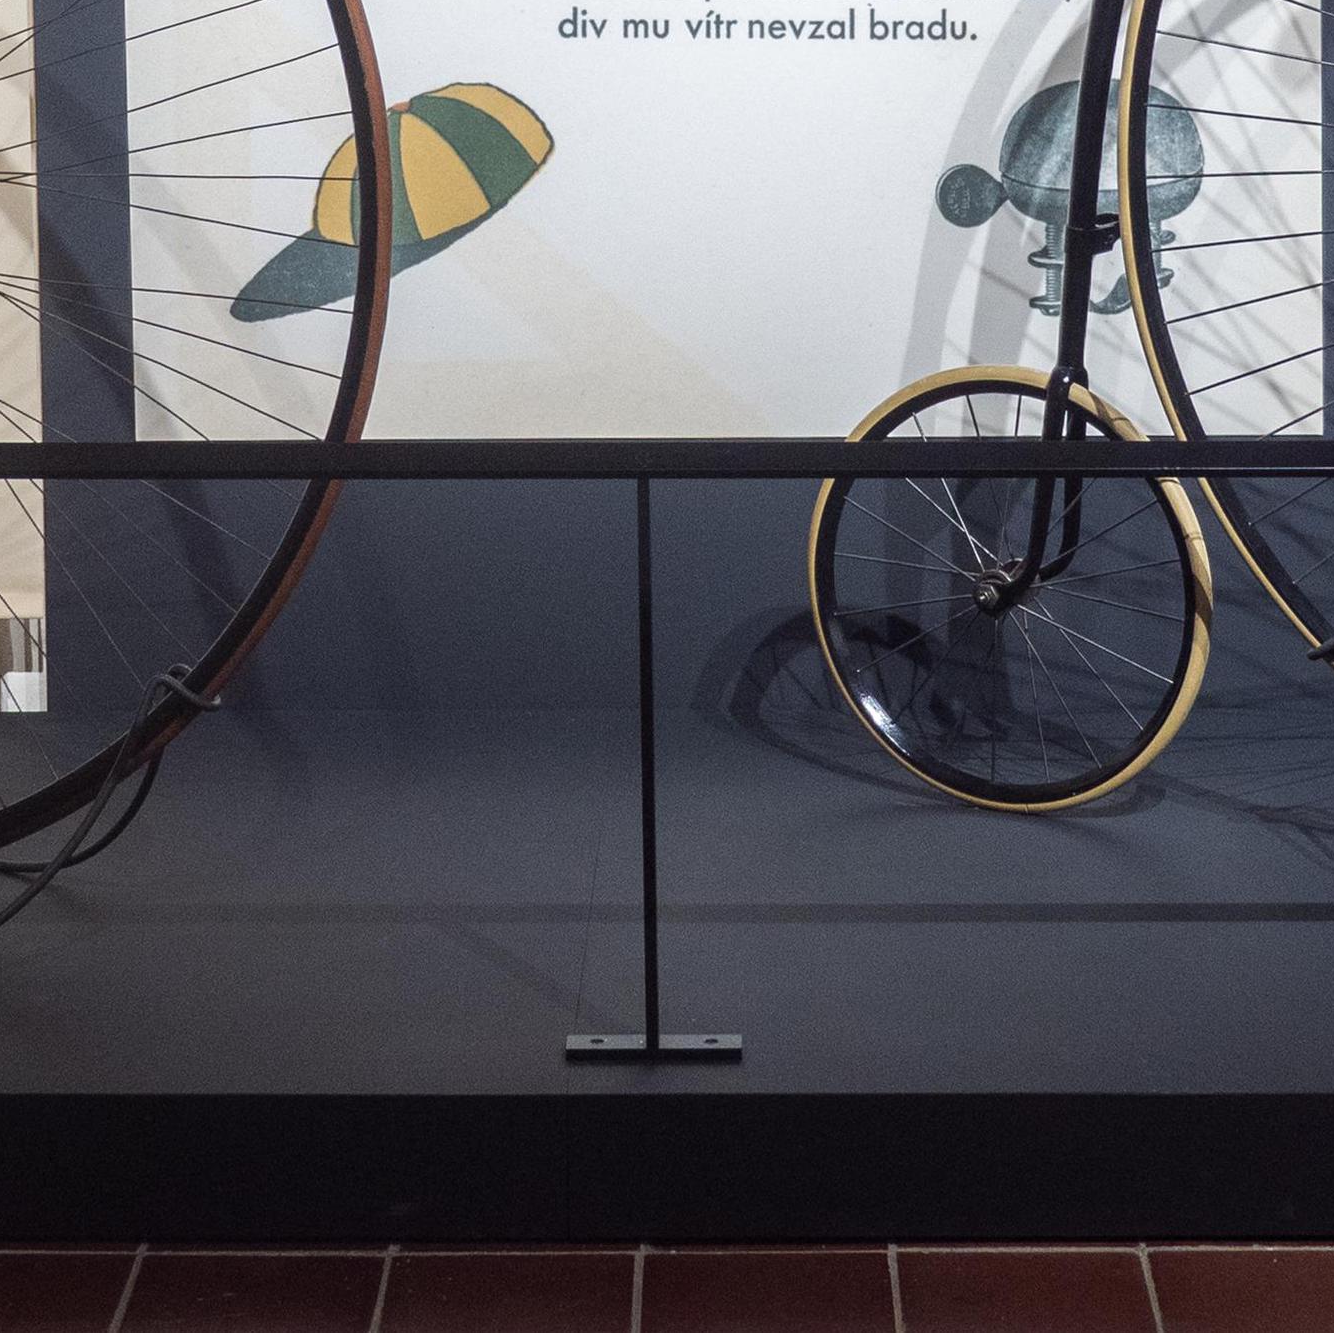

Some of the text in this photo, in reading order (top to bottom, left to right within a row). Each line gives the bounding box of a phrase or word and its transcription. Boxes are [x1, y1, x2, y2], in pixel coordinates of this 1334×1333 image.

[557, 7, 977, 41] div mu vítr nevzal bradu.
